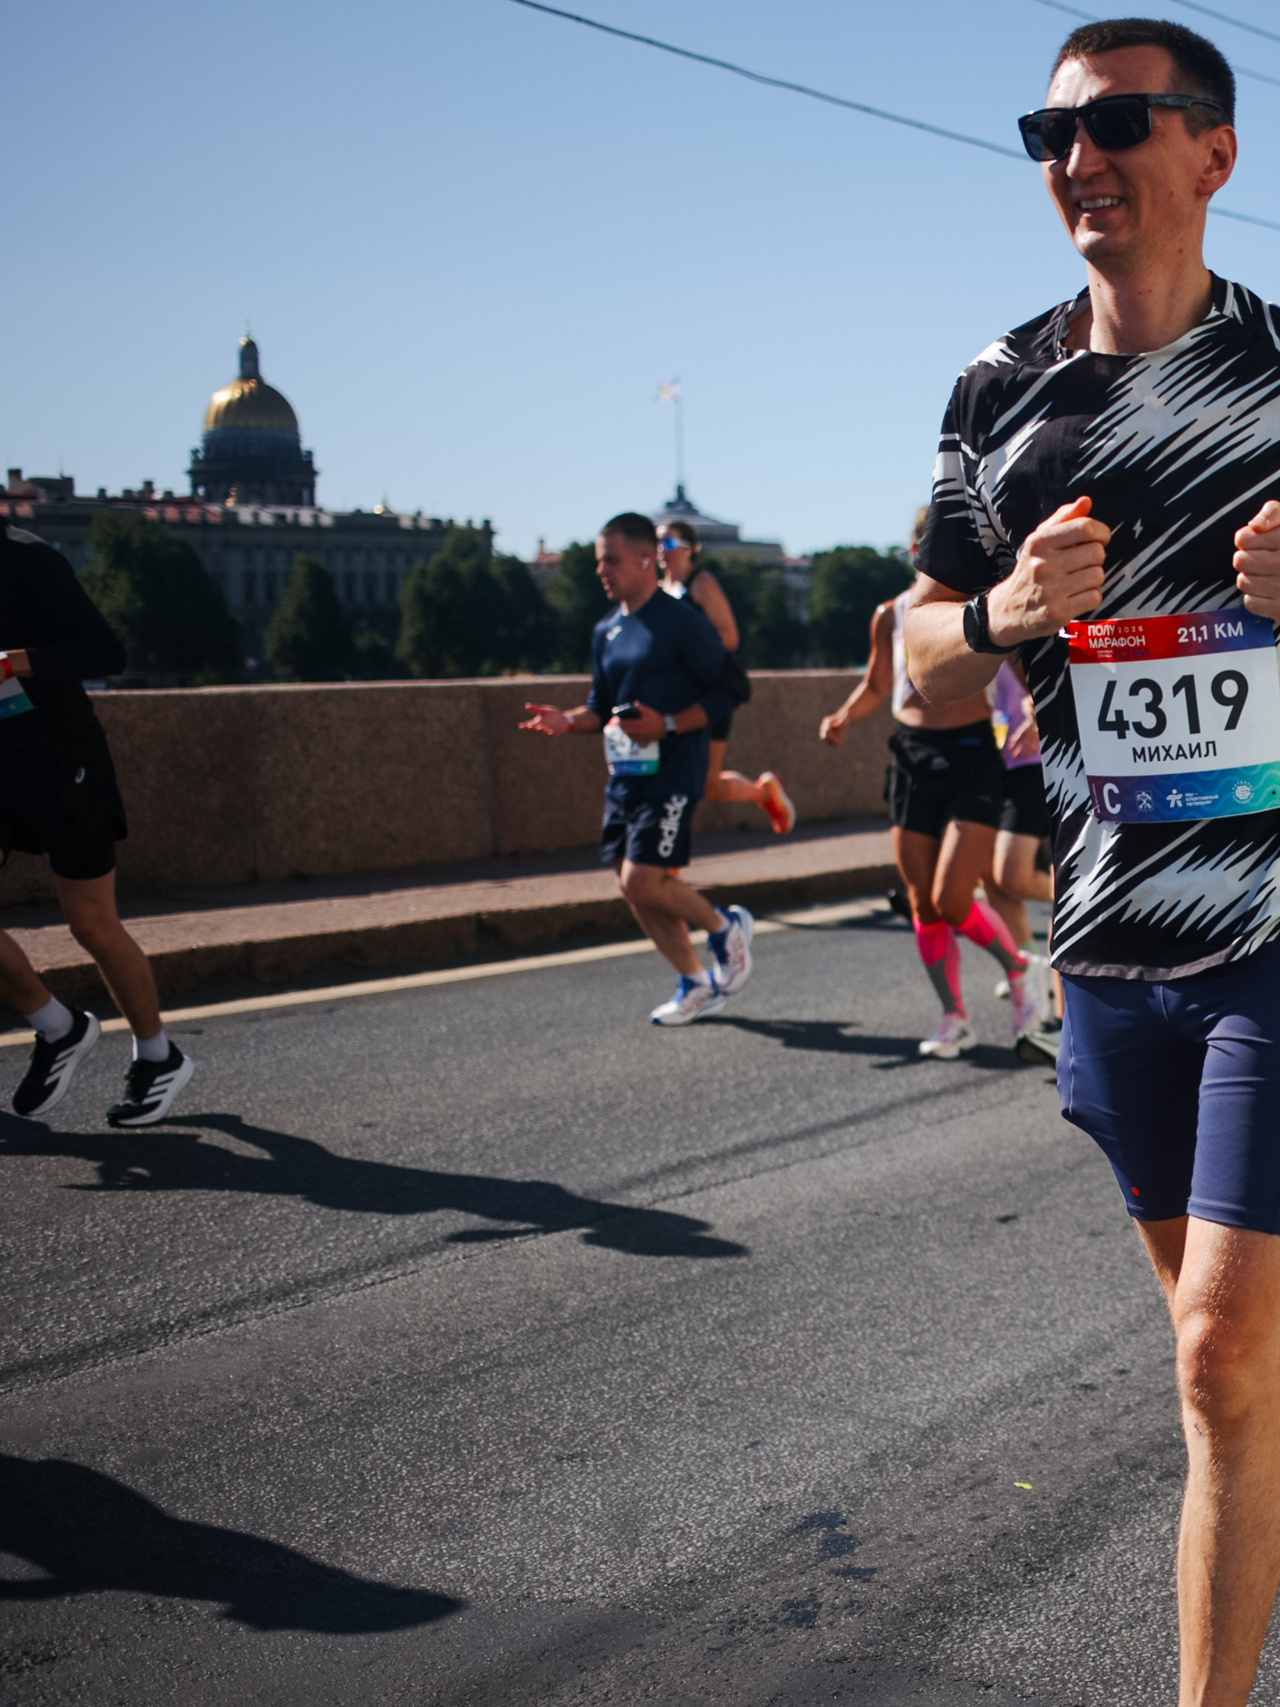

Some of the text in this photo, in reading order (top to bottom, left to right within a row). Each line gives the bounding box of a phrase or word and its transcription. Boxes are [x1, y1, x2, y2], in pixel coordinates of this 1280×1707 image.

[1087, 624, 1144, 637] ПОЛУ 2026
[1177, 625, 1209, 643] 21,1
[1088, 635, 1146, 649] МАРАФОН
[1097, 669, 1249, 740] 4319
[1132, 740, 1217, 763] МИХАИЛ
[657, 794, 688, 858] adida
